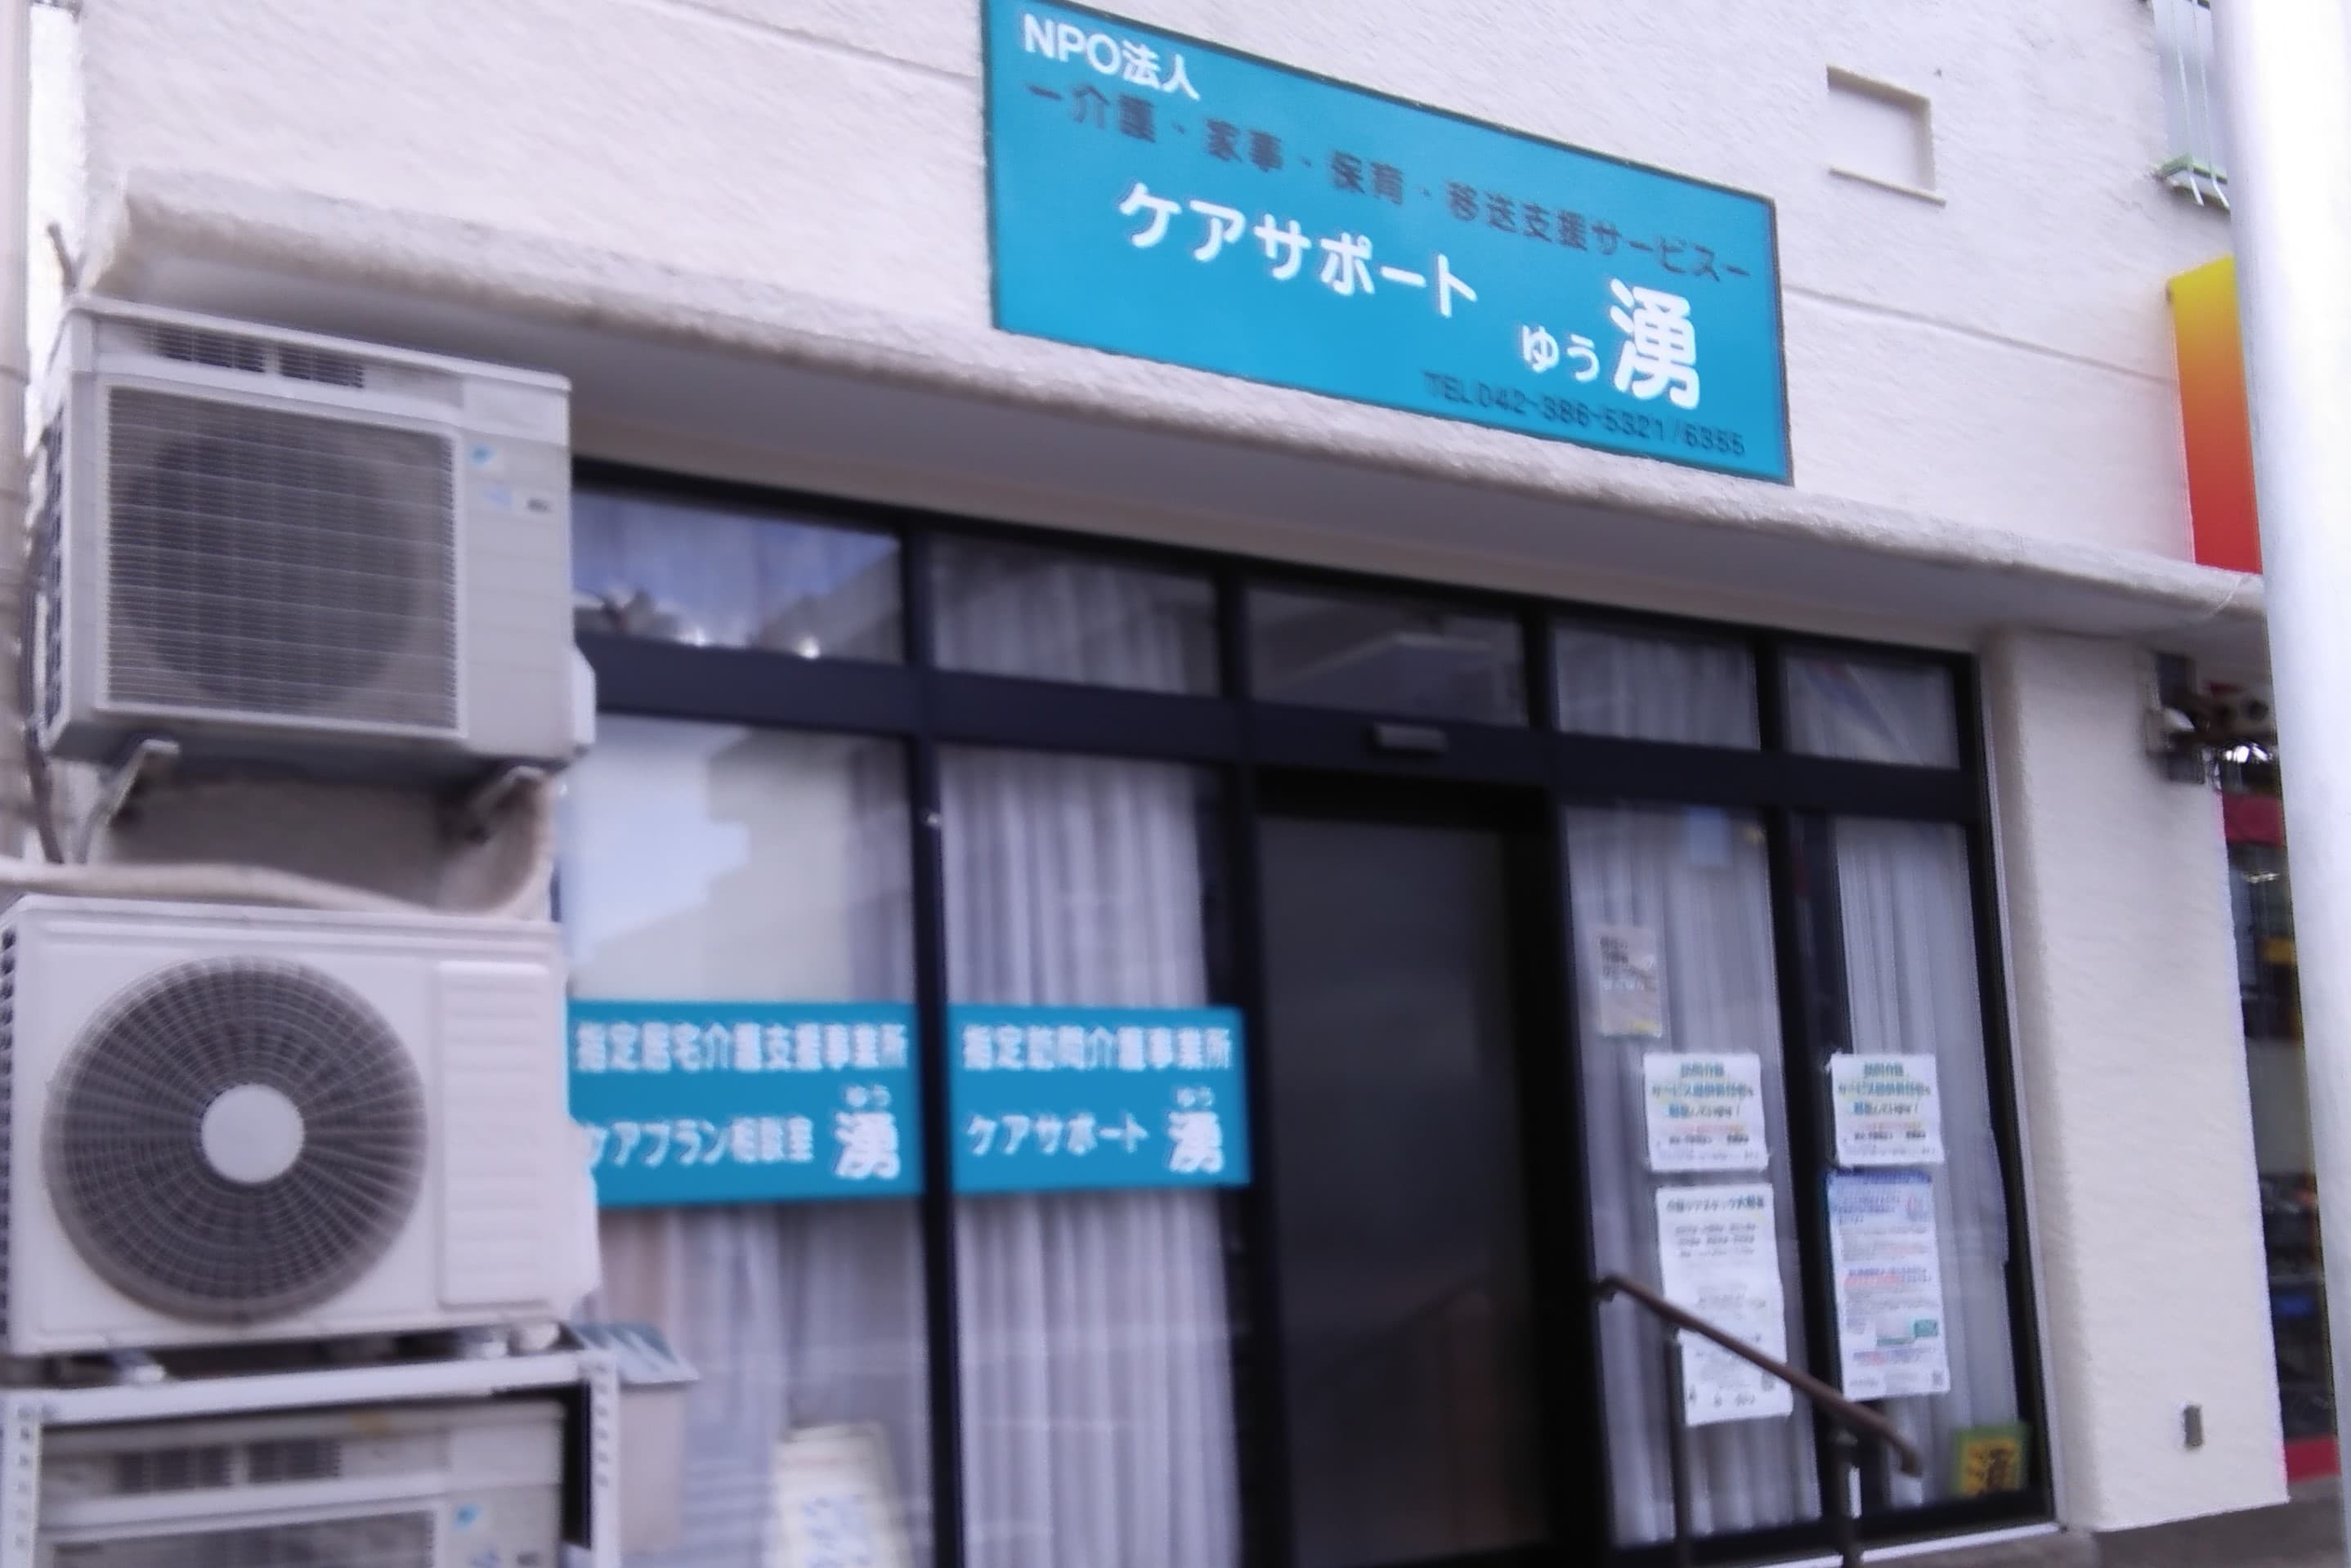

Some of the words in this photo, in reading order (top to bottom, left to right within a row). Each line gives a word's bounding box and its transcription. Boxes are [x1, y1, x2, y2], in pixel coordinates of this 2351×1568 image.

[1023, 13, 1200, 100] NPO法人
[1118, 181, 1479, 319] ケアサポート
[1520, 325, 1601, 382] ゆう
[1610, 278, 1701, 410] 湧
